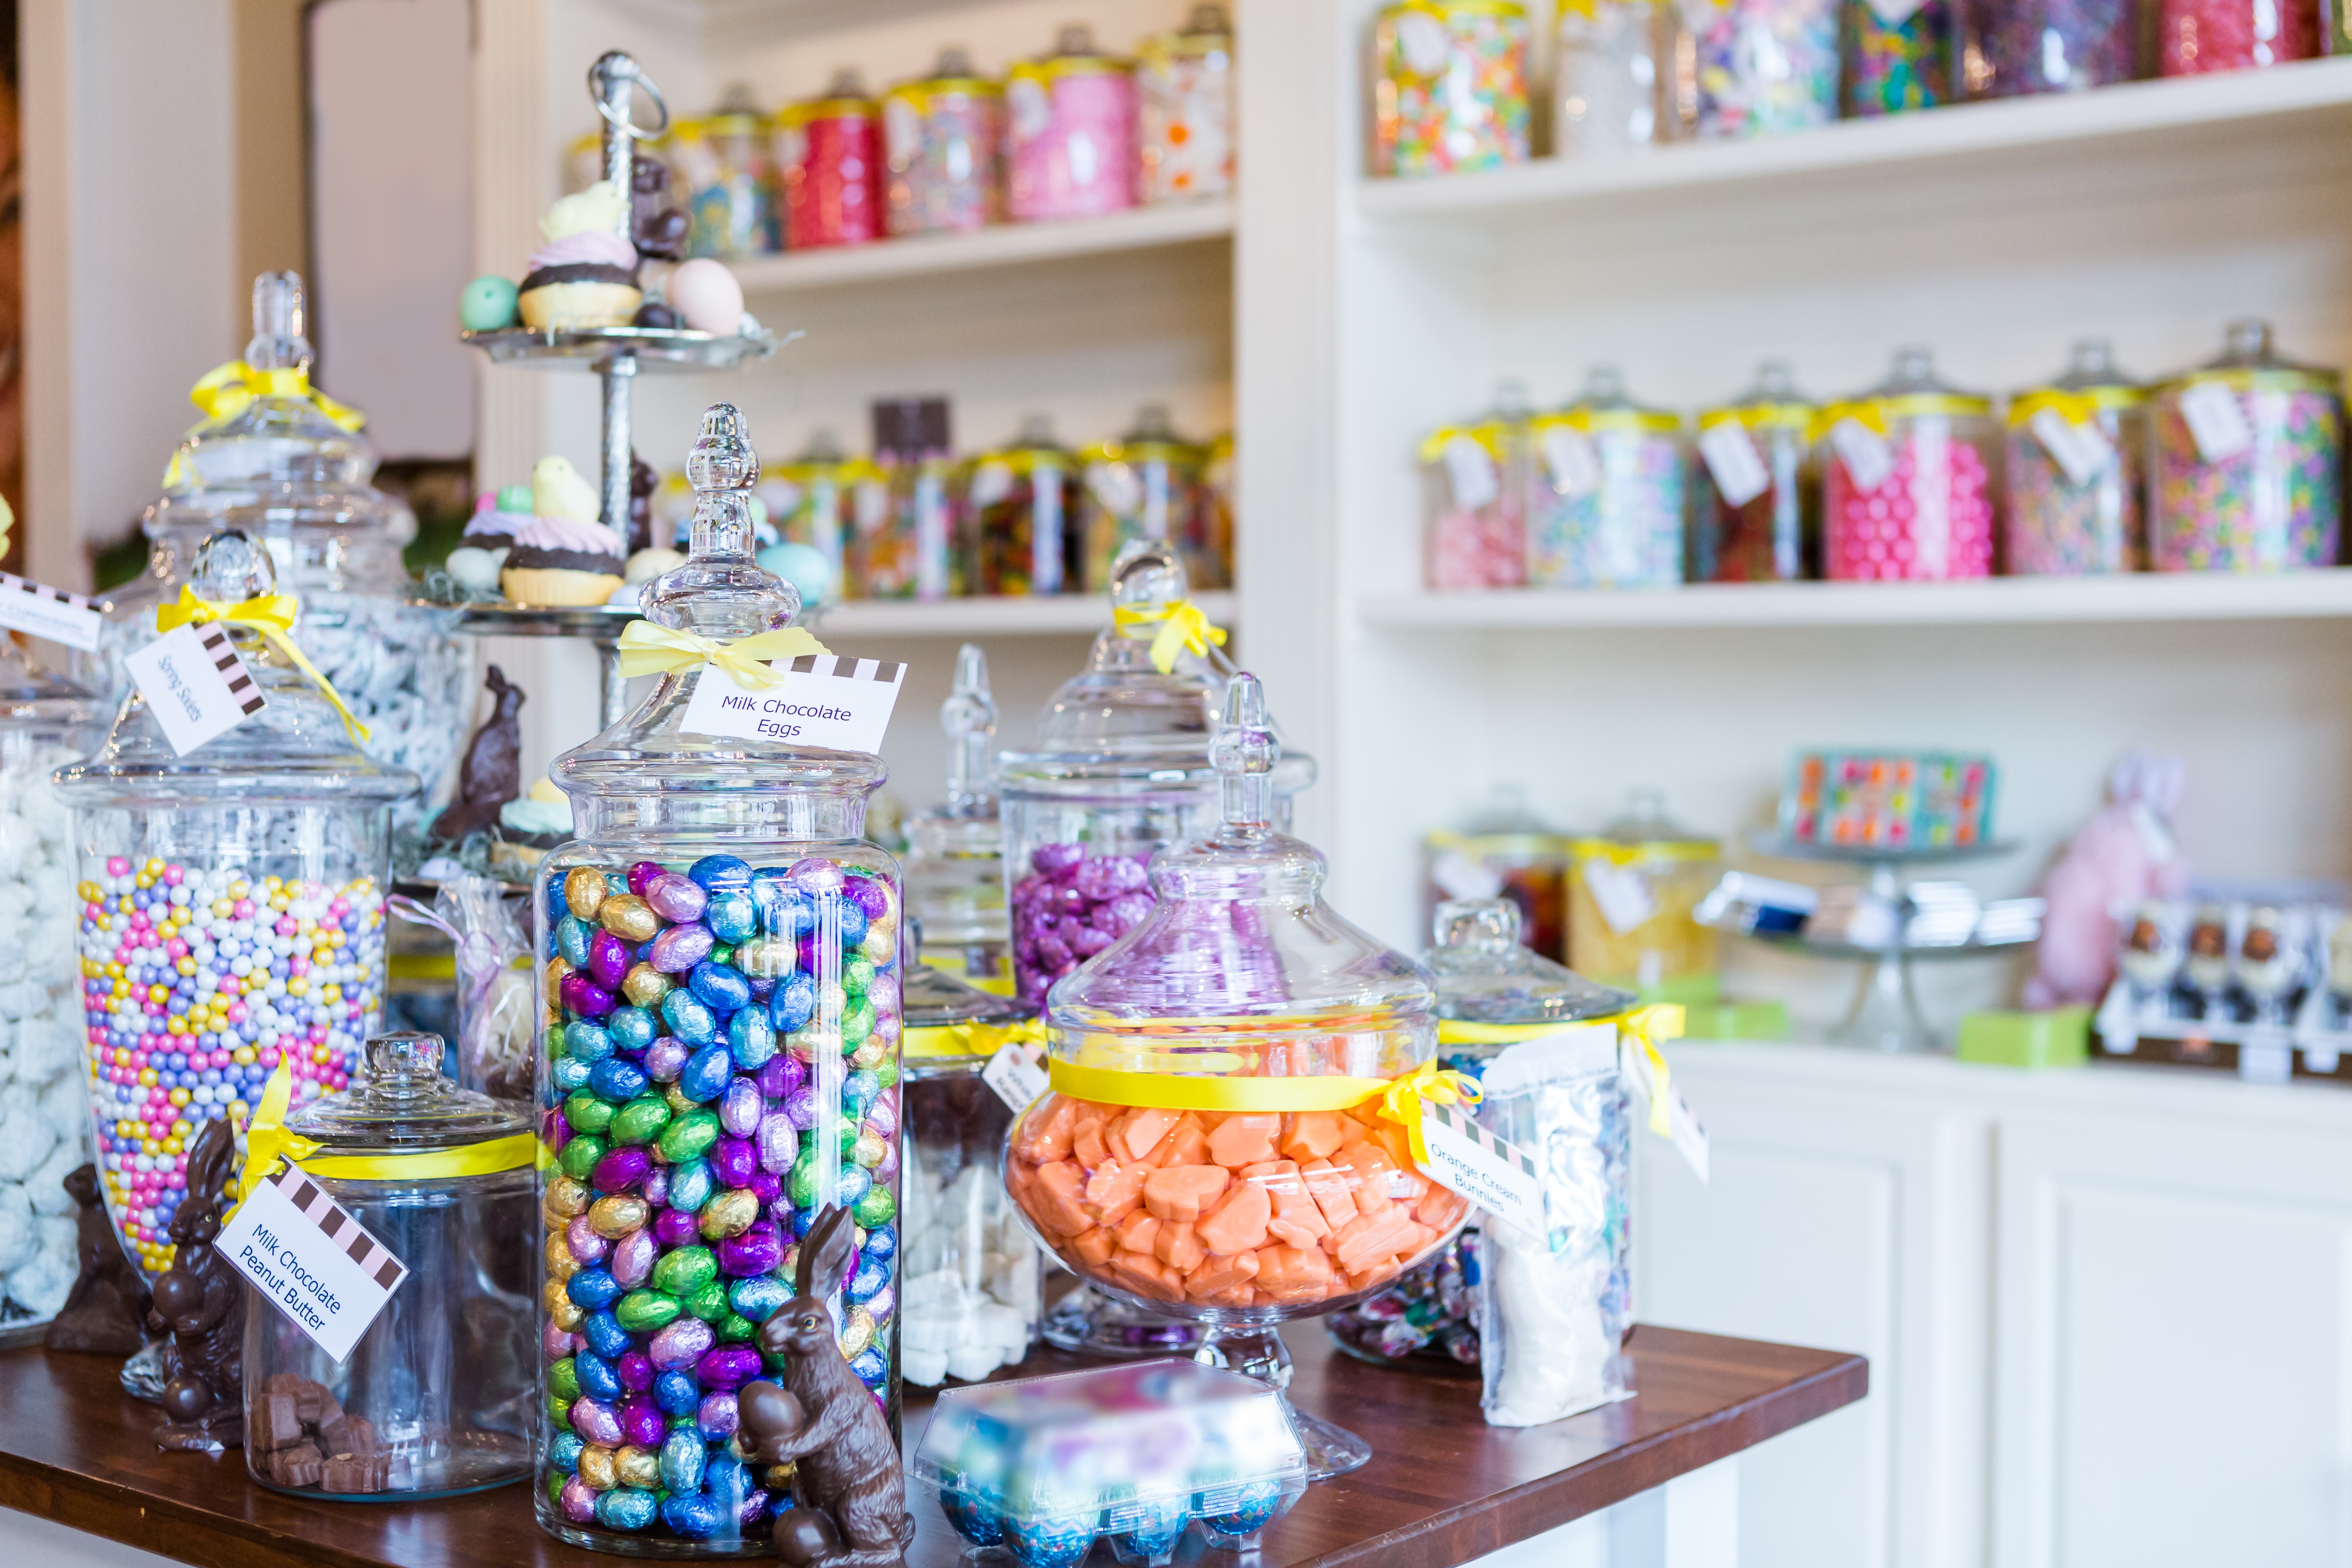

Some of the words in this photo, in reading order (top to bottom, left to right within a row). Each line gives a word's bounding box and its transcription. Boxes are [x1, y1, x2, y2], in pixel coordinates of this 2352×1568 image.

[158, 655, 182, 690] Spring
[722, 696, 757, 711] Milk
[763, 699, 851, 722] Chocolate
[757, 719, 802, 737] Eggs
[1431, 1144, 1478, 1178] Orange
[1482, 1173, 1521, 1206] Cream
[1455, 1173, 1504, 1212] Bunnies
[239, 1245, 285, 1294] Peanut
[284, 1287, 325, 1331] Butter
[252, 1224, 281, 1256] Milk
[280, 1250, 341, 1314] Chocolate
